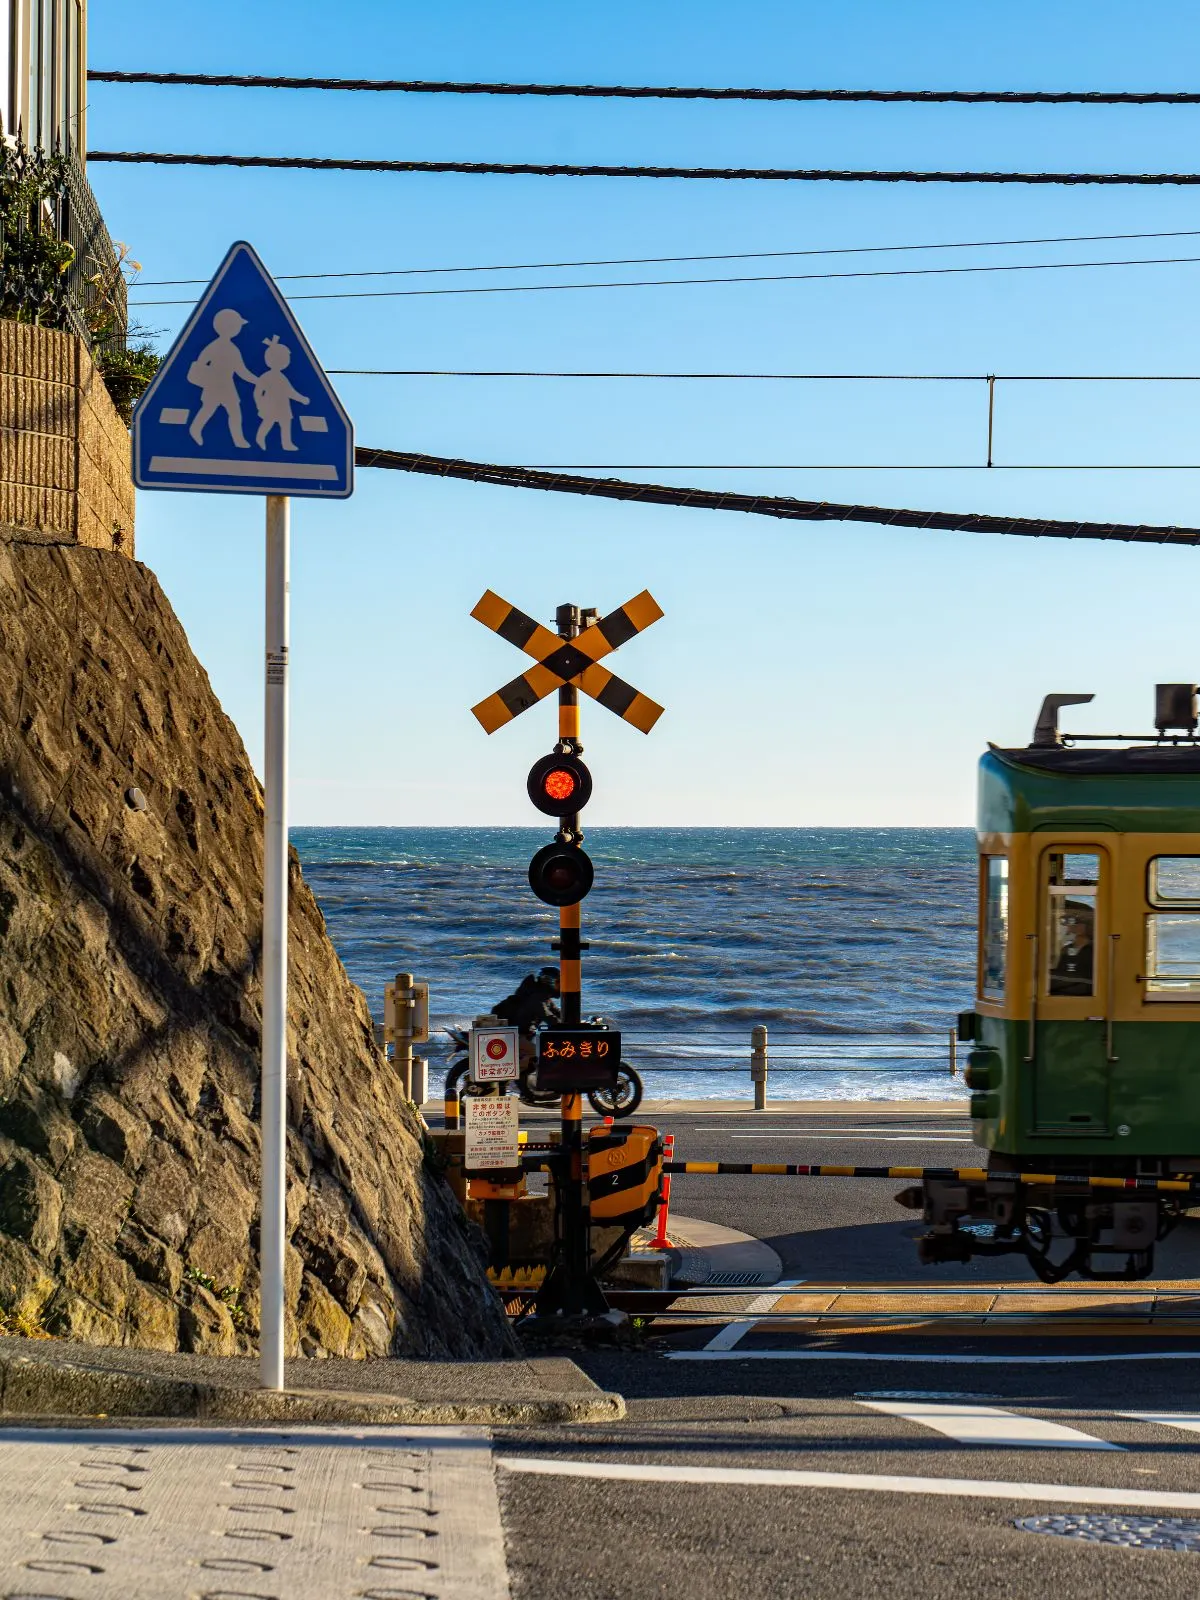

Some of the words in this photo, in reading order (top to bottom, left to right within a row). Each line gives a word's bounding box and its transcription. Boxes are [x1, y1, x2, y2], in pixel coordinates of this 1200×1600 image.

[543, 1041, 609, 1058] ふみきり
[480, 1067, 515, 1077] 非常ボタン
[472, 1103, 511, 1111] 非常の際は
[472, 1110, 512, 1118] このボタンを
[612, 1174, 619, 1185] 2
